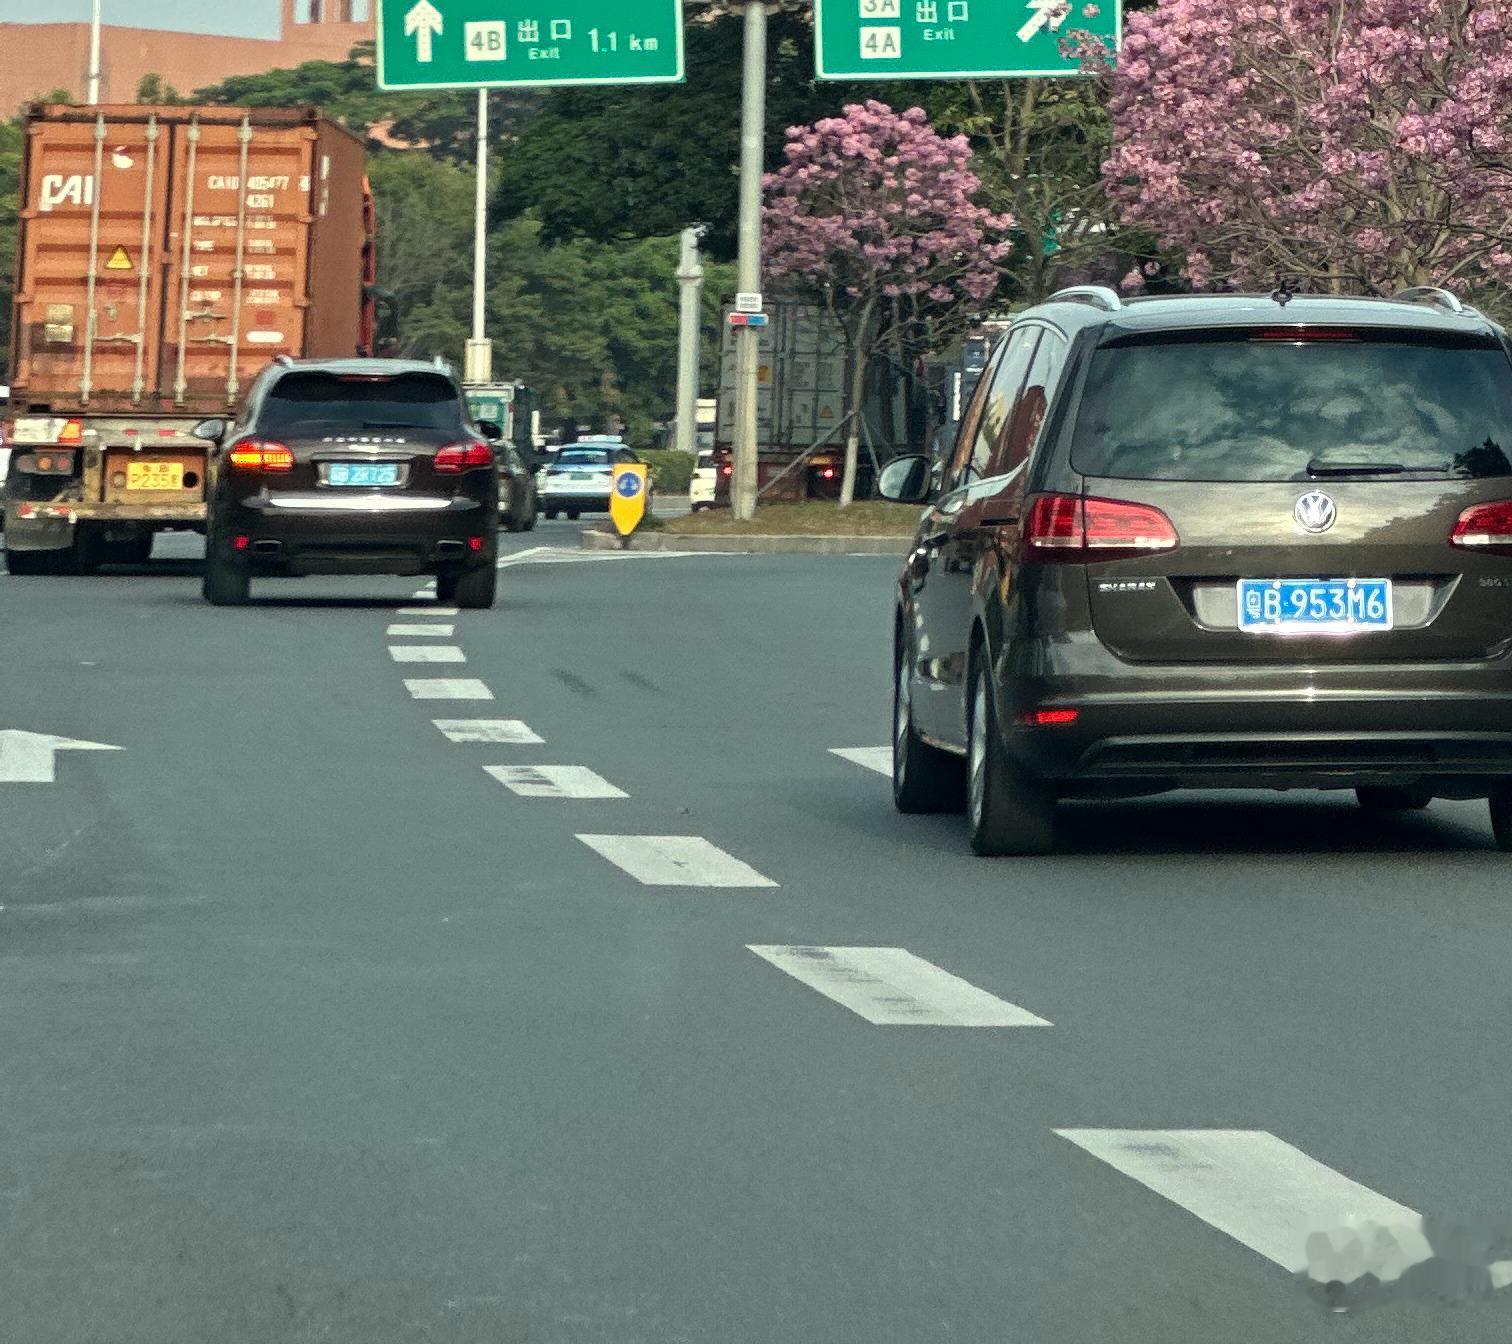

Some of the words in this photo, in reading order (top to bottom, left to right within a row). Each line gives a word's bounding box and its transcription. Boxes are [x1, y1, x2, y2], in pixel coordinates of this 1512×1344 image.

[915, 0, 969, 24] 出口
[469, 30, 502, 52] 4B
[517, 18, 573, 43] 出口
[923, 28, 955, 41] Exit
[528, 46, 560, 60] Exit
[629, 33, 659, 52] km
[864, 32, 897, 54] 4A
[39, 174, 94, 212] CAI
